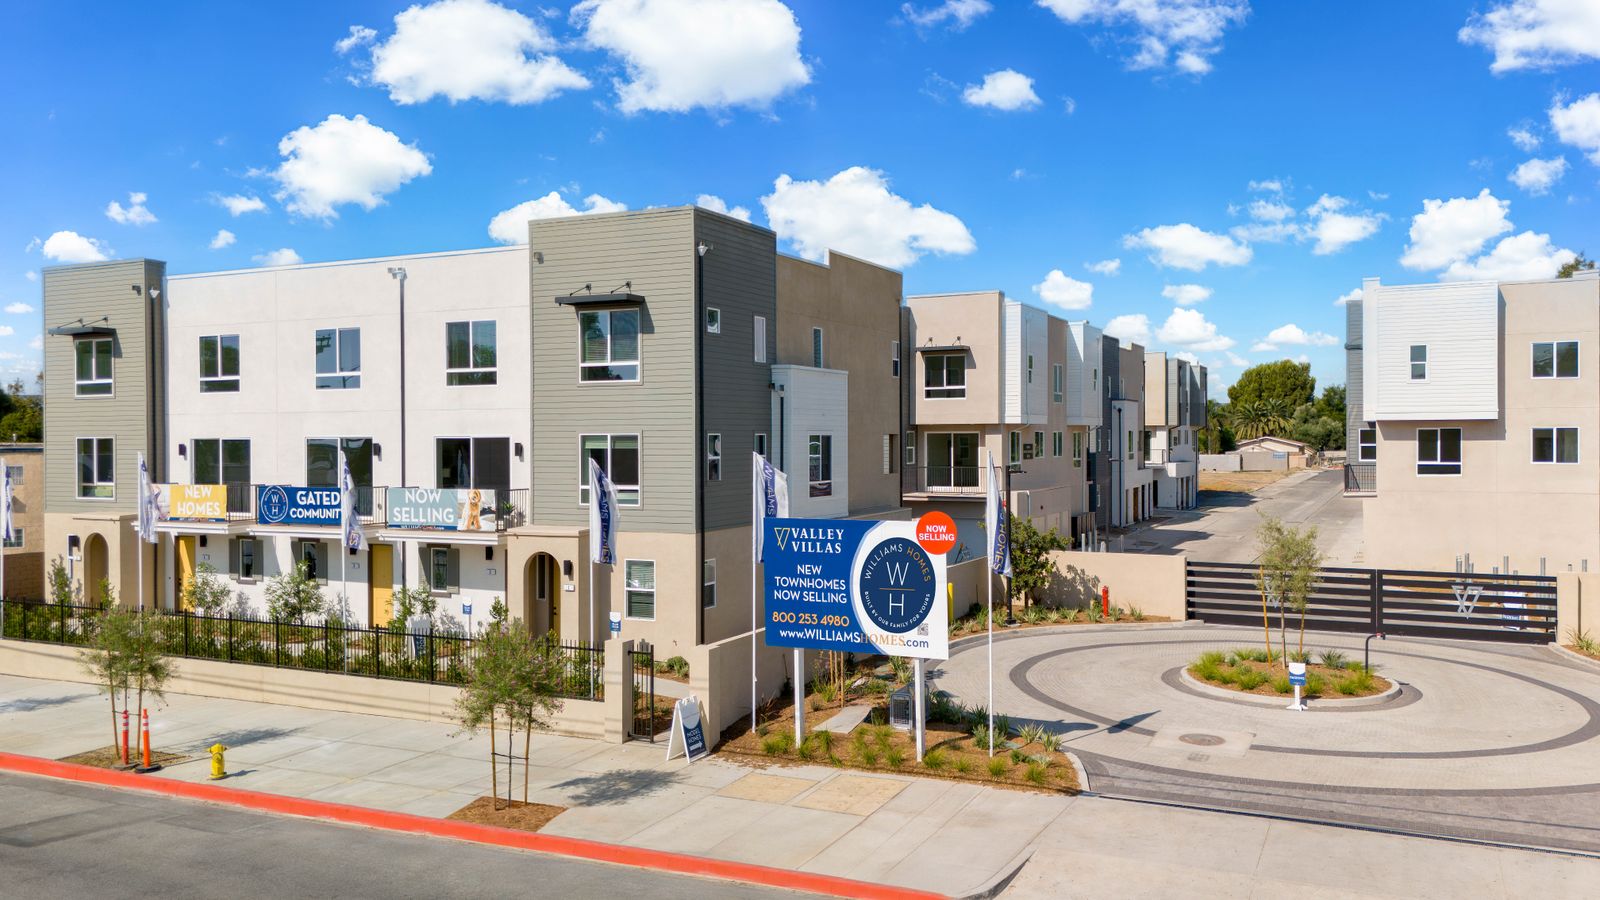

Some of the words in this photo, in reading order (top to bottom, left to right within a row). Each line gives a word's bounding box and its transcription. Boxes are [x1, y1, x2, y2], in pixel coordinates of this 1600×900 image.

[184, 485, 213, 499] NEW
[296, 490, 341, 506] GATED
[405, 488, 442, 504] NOW
[177, 501, 221, 516] HOMES
[290, 508, 341, 519] COMMUNIT
[393, 507, 454, 523] SELLING
[792, 527, 844, 540] VALLEY
[926, 524, 947, 533] NOW
[918, 533, 955, 542] SELLING
[792, 541, 842, 554] VILLAS
[797, 564, 822, 575] NEW
[865, 543, 903, 579] WILLIAMS
[906, 546, 931, 583] HOMES
[886, 562, 909, 586] W
[774, 576, 846, 590] TOWNHOMES
[774, 590, 799, 601] NOW
[802, 591, 847, 604] SELLING
[889, 593, 905, 616] H
[864, 591, 873, 609] BUILT
[871, 609, 878, 617] BY
[878, 616, 889, 626] OUR
[909, 613, 920, 624] FOR
[919, 593, 931, 614] YOURS
[772, 611, 796, 623] 800
[798, 613, 817, 625] 253
[820, 614, 850, 627] 4980
[779, 627, 929, 649] www.WILLIAMSHOMES.com
